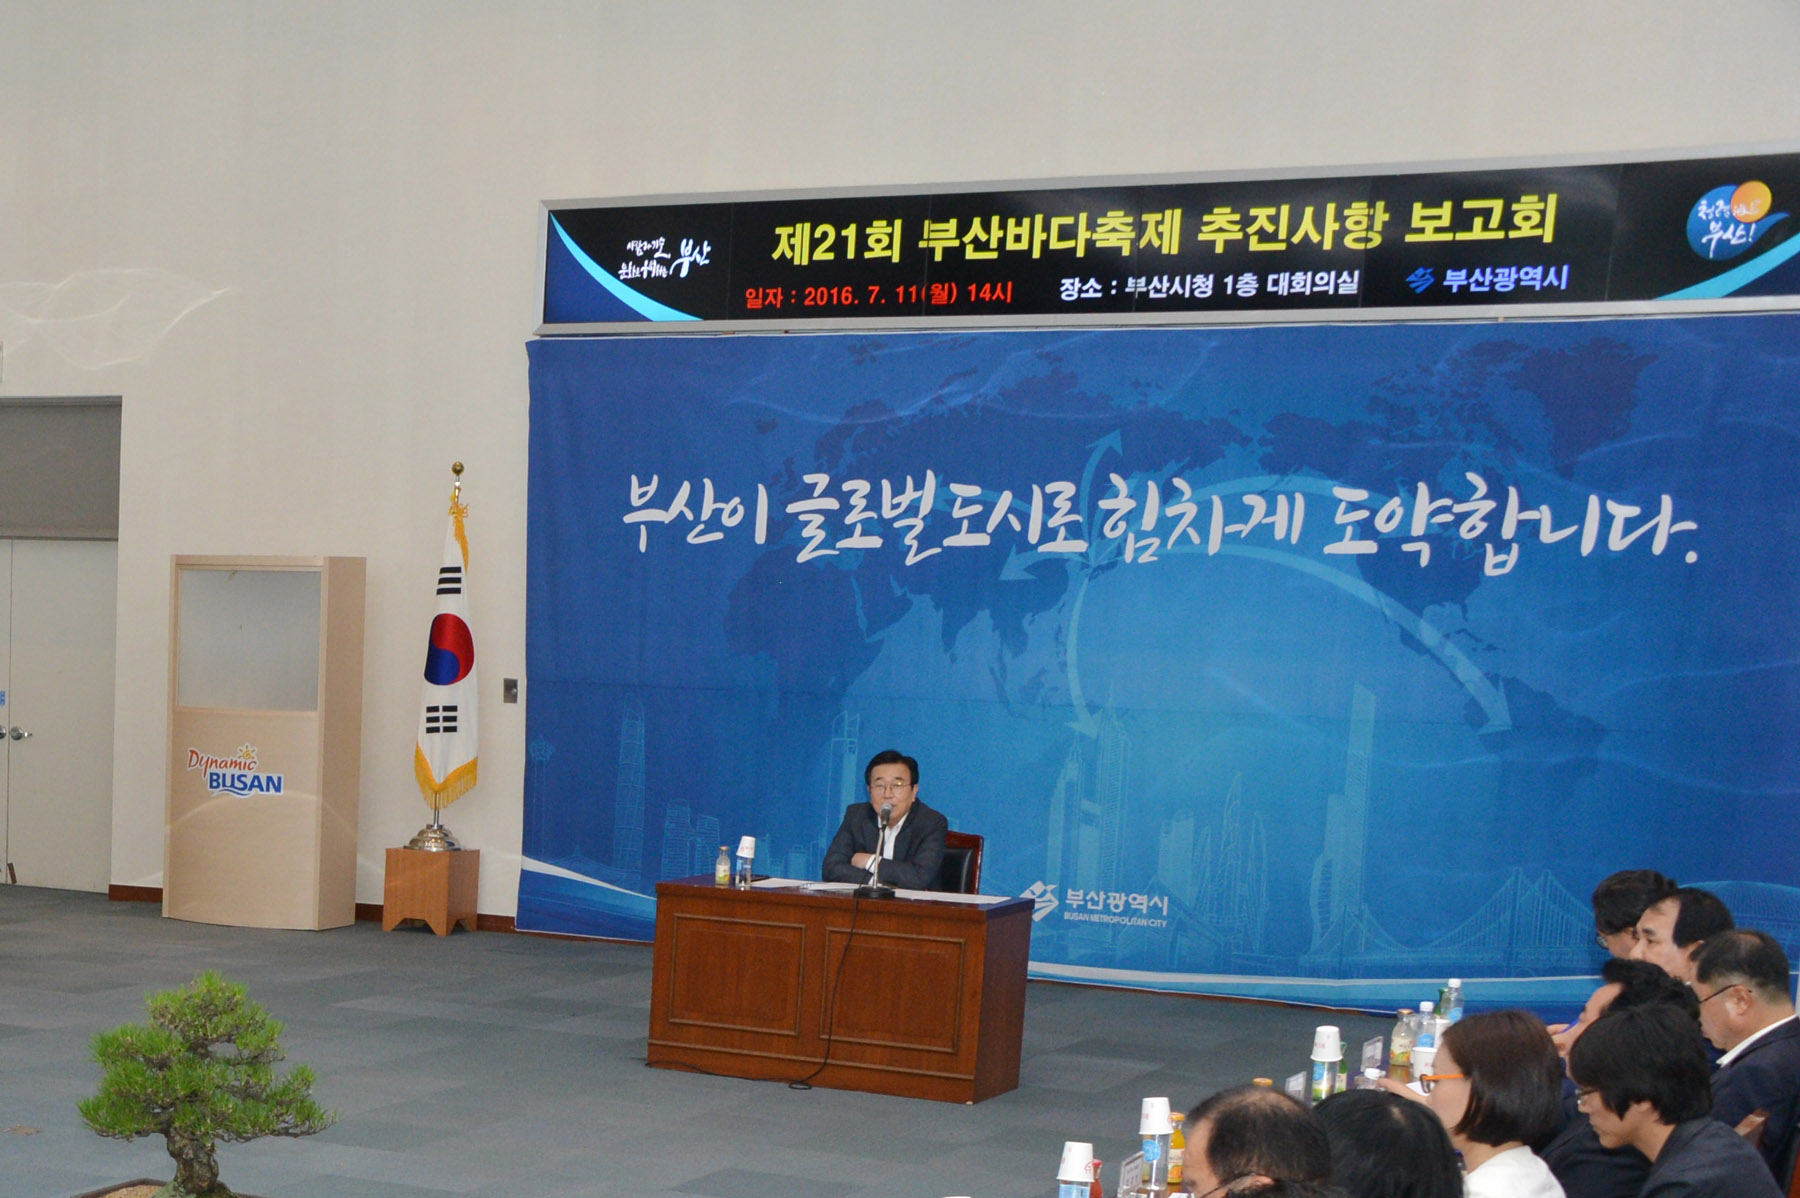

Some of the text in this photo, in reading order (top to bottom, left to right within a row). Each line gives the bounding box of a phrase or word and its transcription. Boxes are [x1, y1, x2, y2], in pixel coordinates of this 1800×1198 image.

[771, 193, 1558, 266] 제21회 부산바다축제 추진사항 보고회
[669, 238, 712, 278] 부산
[745, 286, 783, 310] 일자
[803, 285, 858, 307] 2016.
[868, 284, 885, 304] 7.
[896, 278, 958, 305] 11(월)
[967, 279, 1013, 304] 14시
[1059, 275, 1103, 301] 장소
[1125, 273, 1215, 299] 부산시청
[1224, 271, 1260, 296] 1층
[1266, 269, 1361, 297] 대회의실
[1443, 264, 1570, 294] 부산광역시
[622, 473, 769, 553] 부산이
[1097, 472, 1306, 563] 힘차게
[1323, 471, 1699, 577] 도약합니다.
[187, 748, 257, 778] Dynamic
[208, 772, 283, 793] BUSAN
[1066, 889, 1168, 916] 부산광역시
[1064, 911, 1168, 929] BUSAN METROPOLITAN CITY
